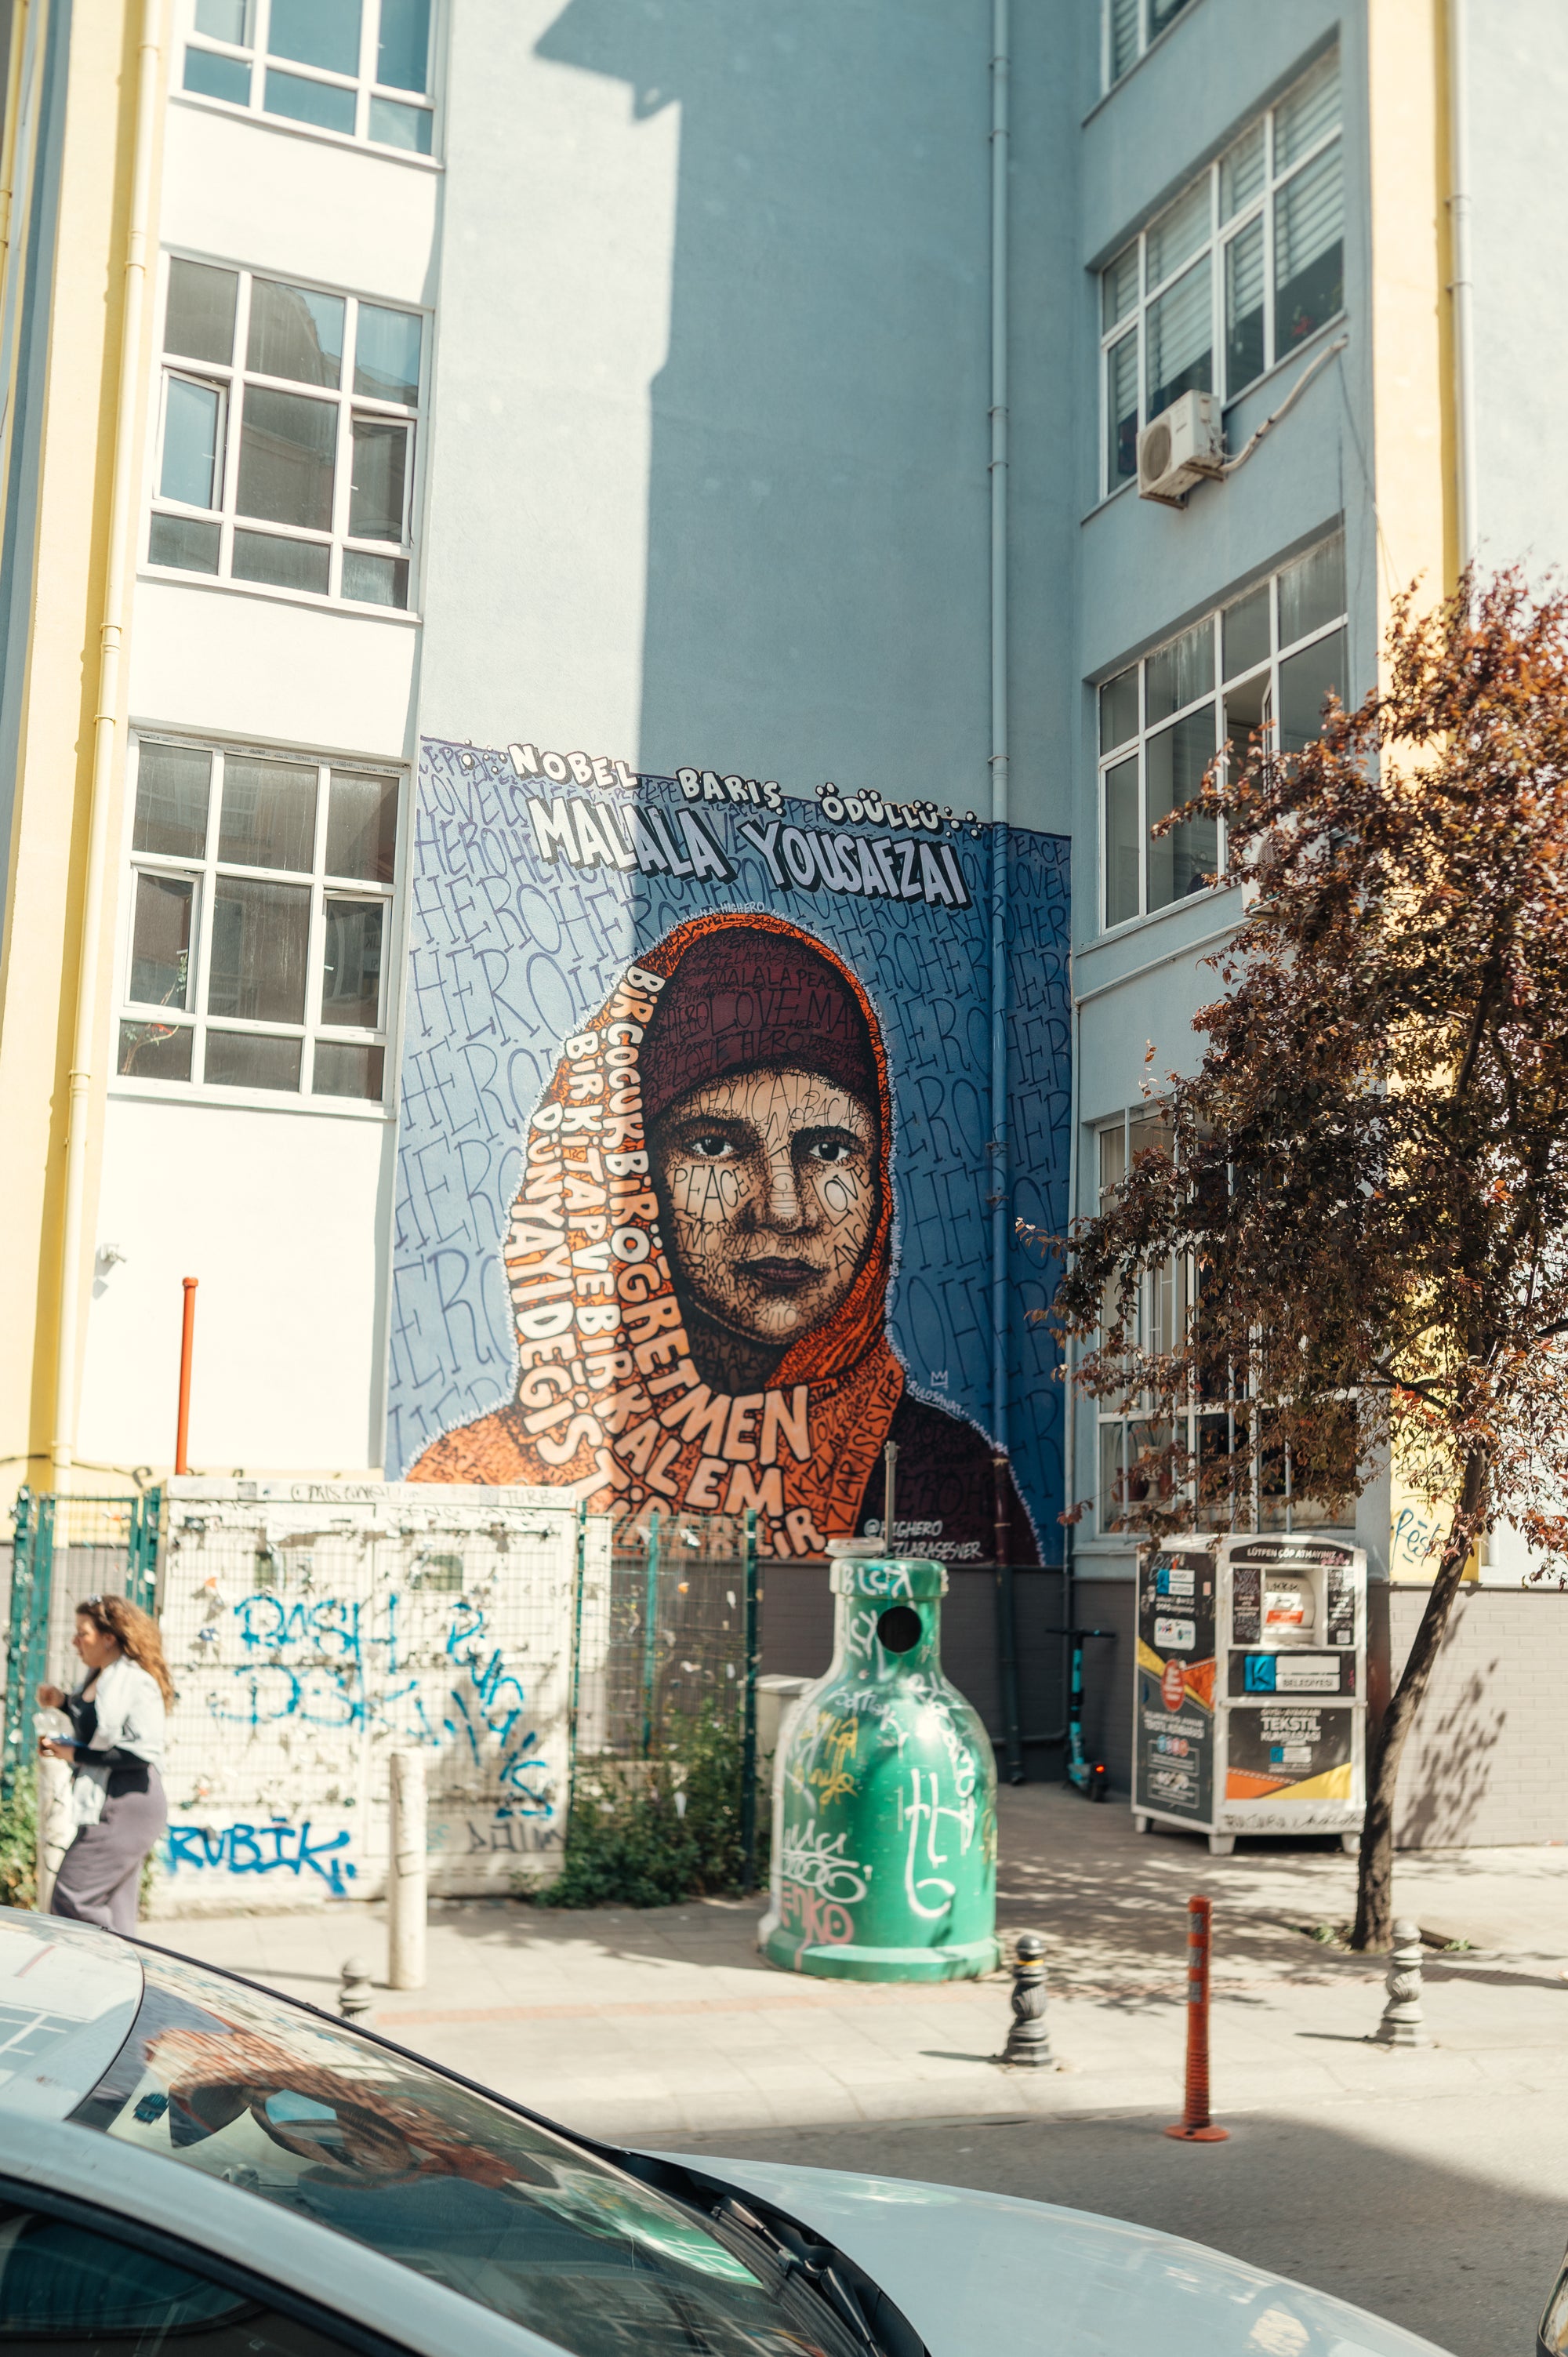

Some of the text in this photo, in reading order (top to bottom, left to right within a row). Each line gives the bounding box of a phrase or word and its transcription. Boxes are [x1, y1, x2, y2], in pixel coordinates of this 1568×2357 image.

[508, 743, 942, 833] NOBEL BARIŞ ÖDÜLLÜ
[526, 796, 971, 909] MALALA YOUSAFZAI
[610, 965, 666, 1024] BİR
[565, 1031, 605, 1102] BİR
[601, 1022, 646, 1149] ÇOCUK
[503, 1102, 575, 1305] DÜNYAYI
[560, 1104, 608, 1240] KİTAP
[605, 1149, 659, 1227] BİR
[672, 1164, 750, 1222] PEACE
[572, 1240, 615, 1296] VE
[575, 1304, 633, 1391] BİR
[610, 1223, 812, 1465] ÖĞRETMEN
[592, 1382, 784, 1519] KALEM
